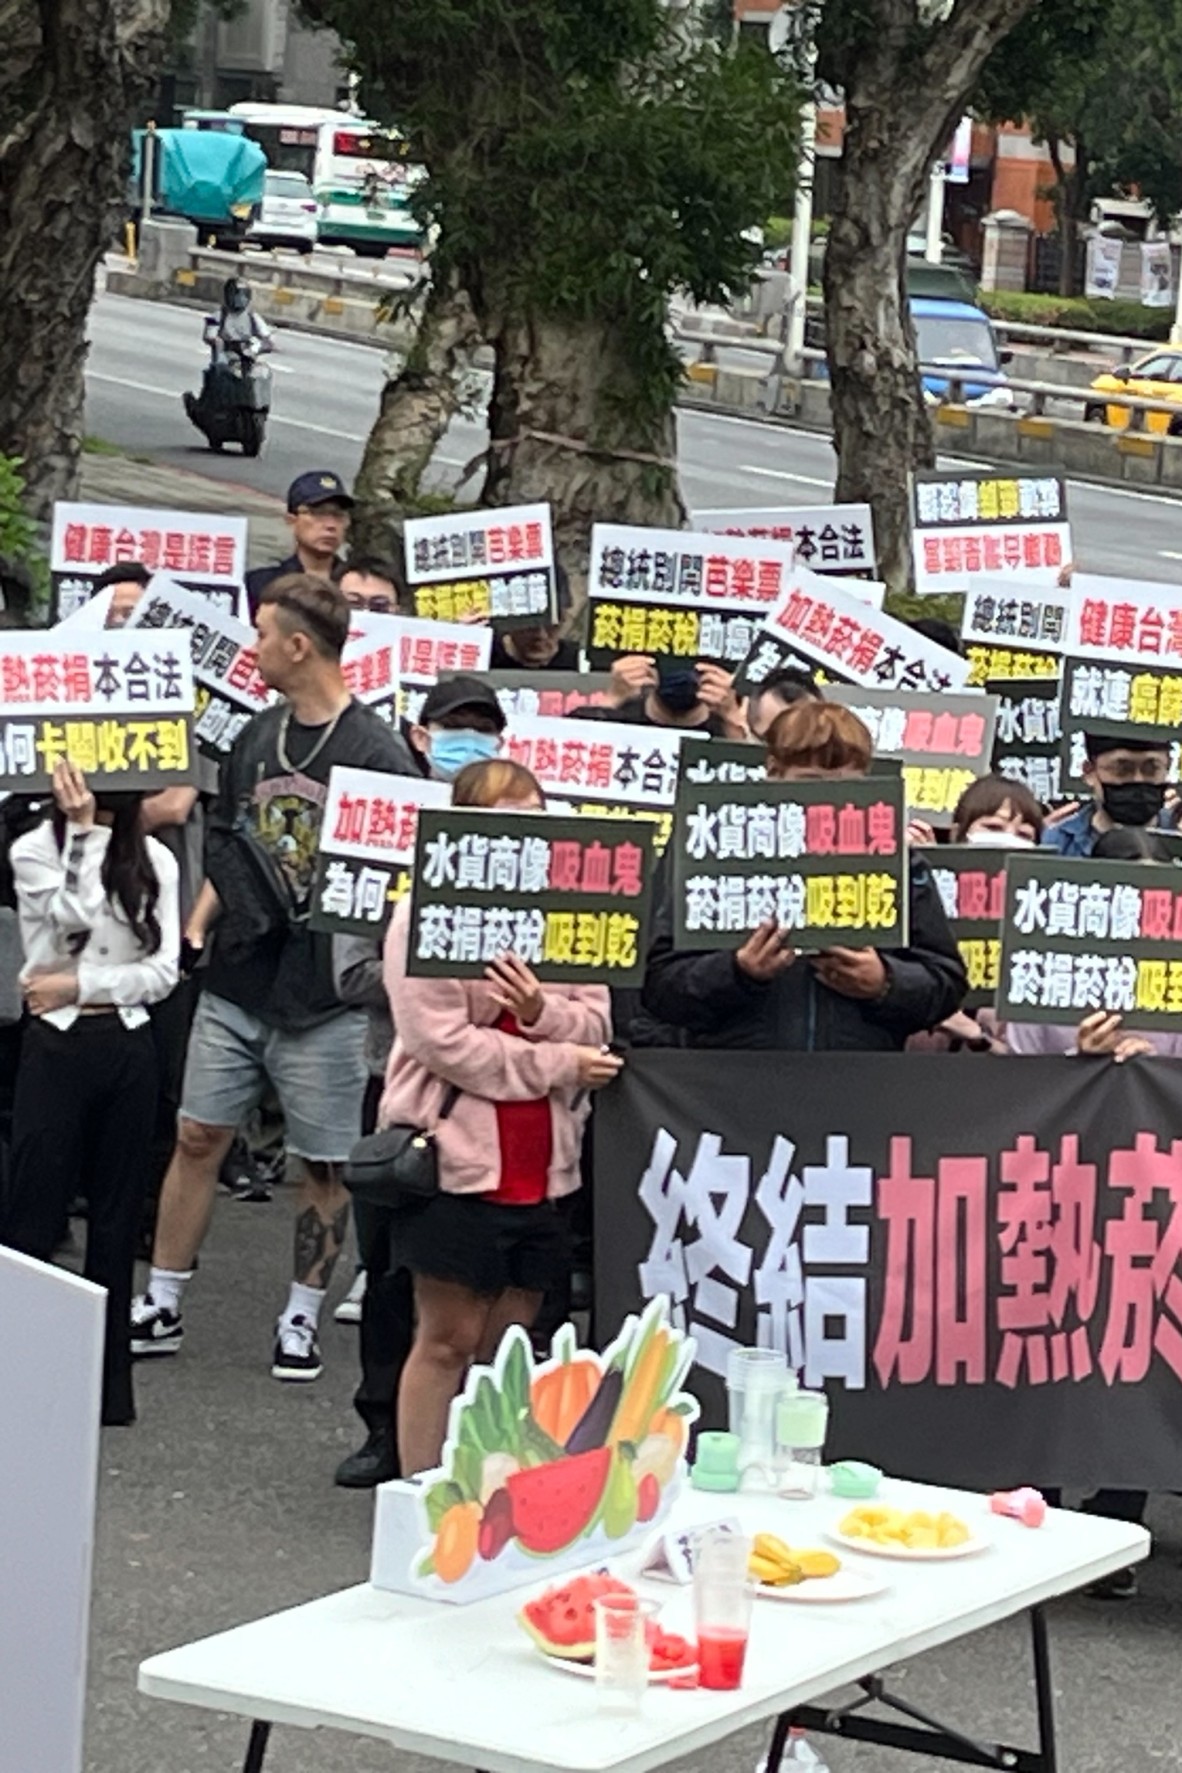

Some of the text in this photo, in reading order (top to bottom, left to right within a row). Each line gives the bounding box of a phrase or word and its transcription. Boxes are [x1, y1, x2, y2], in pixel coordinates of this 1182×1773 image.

[64, 523, 236, 576] 健康台灣是謊言
[414, 522, 544, 573] 總統別開芭樂票
[600, 545, 783, 602] 總統別開芭樂票
[0, 719, 189, 775] 何卡關收不到
[686, 802, 897, 858] 水貨商像吸血鬼
[422, 832, 642, 896] 水貨商像吸血鬼
[685, 873, 898, 930] 菸捐菸稅吸到乾
[416, 904, 639, 968] 菸捐菸稅吸到乾
